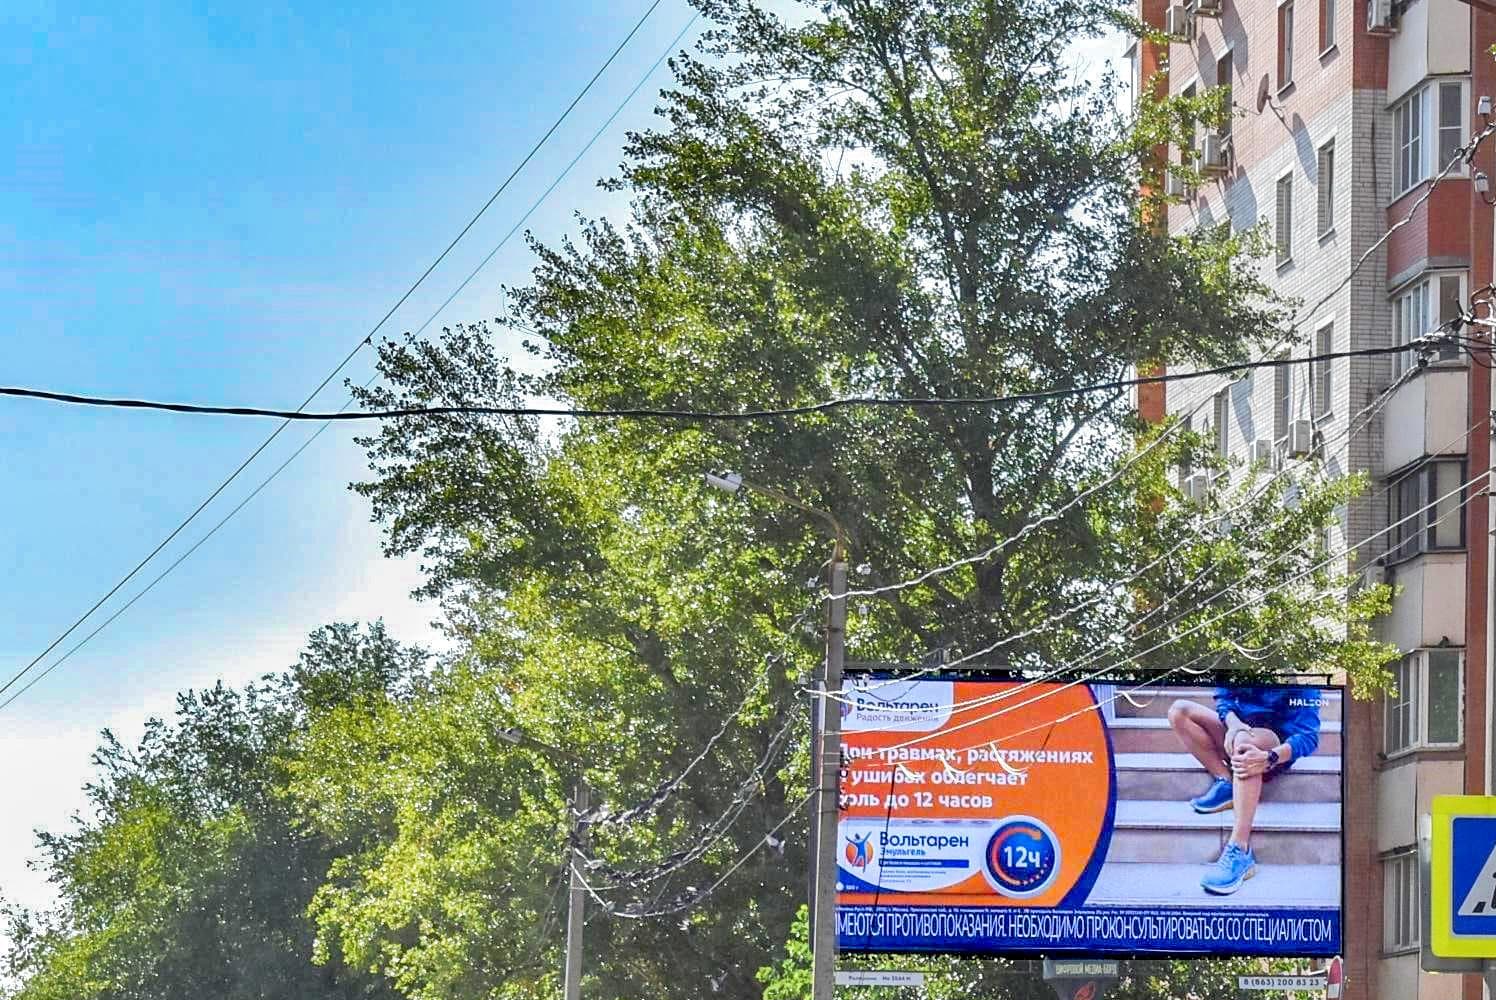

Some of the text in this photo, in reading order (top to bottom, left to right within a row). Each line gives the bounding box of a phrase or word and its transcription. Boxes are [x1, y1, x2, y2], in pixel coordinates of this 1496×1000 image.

[857, 698, 939, 714] Вольтарен
[967, 748, 1093, 765] растяжениях
[884, 794, 909, 809] до
[914, 791, 934, 808] 12
[939, 795, 993, 809] часов
[880, 831, 969, 850] Вольтарен
[1004, 846, 1041, 868] 12ч
[1009, 914, 1084, 941] НЕОБХОДИМО
[1086, 914, 1224, 941] ПРОКОНСУЛЬТИРОВАТЬСЯ
[1226, 918, 1242, 941] СО
[1243, 918, 1332, 943] СПЕЦИАЛИСТОМ
